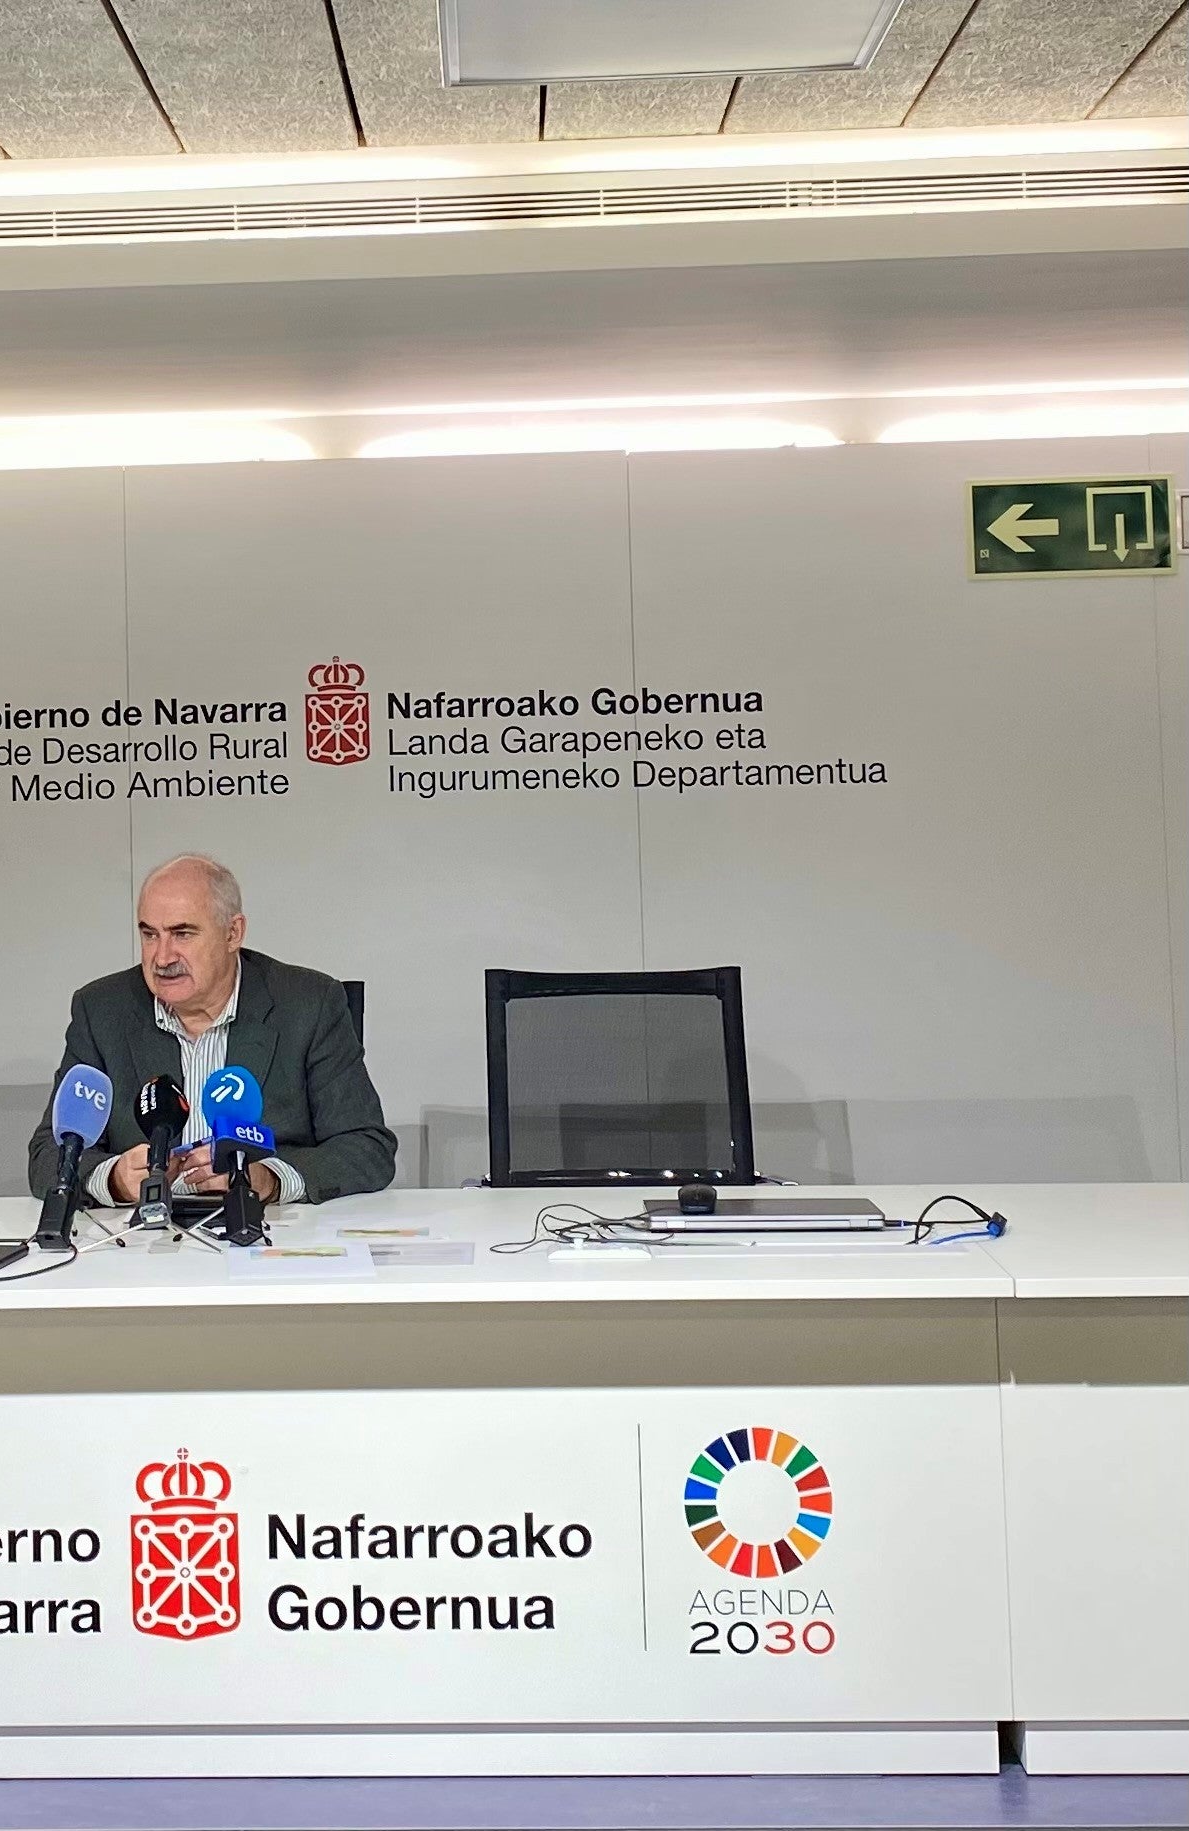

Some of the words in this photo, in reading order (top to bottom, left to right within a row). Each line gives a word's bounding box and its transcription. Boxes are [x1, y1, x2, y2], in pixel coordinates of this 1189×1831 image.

[101, 699, 143, 727] de
[154, 698, 287, 726] Navarra
[387, 689, 579, 720] Nafarroako
[591, 687, 763, 716] Gobernua
[42, 734, 198, 765] Desarrollo
[209, 730, 288, 760] Rural
[388, 726, 490, 756] Landa
[500, 723, 704, 759] Garapeneko
[715, 723, 767, 750] eta
[11, 772, 116, 802] Medio
[126, 769, 290, 799] Ambiente
[389, 761, 620, 799] Ingurumeneko
[632, 758, 888, 794] Departamentua
[74, 1080, 107, 1111] tve
[236, 1125, 265, 1144] etb
[268, 1512, 592, 1560] Nafarroako
[268, 1584, 555, 1632] Gobernua
[688, 1589, 835, 1616] AGENDA
[689, 1620, 835, 1655] 2030
